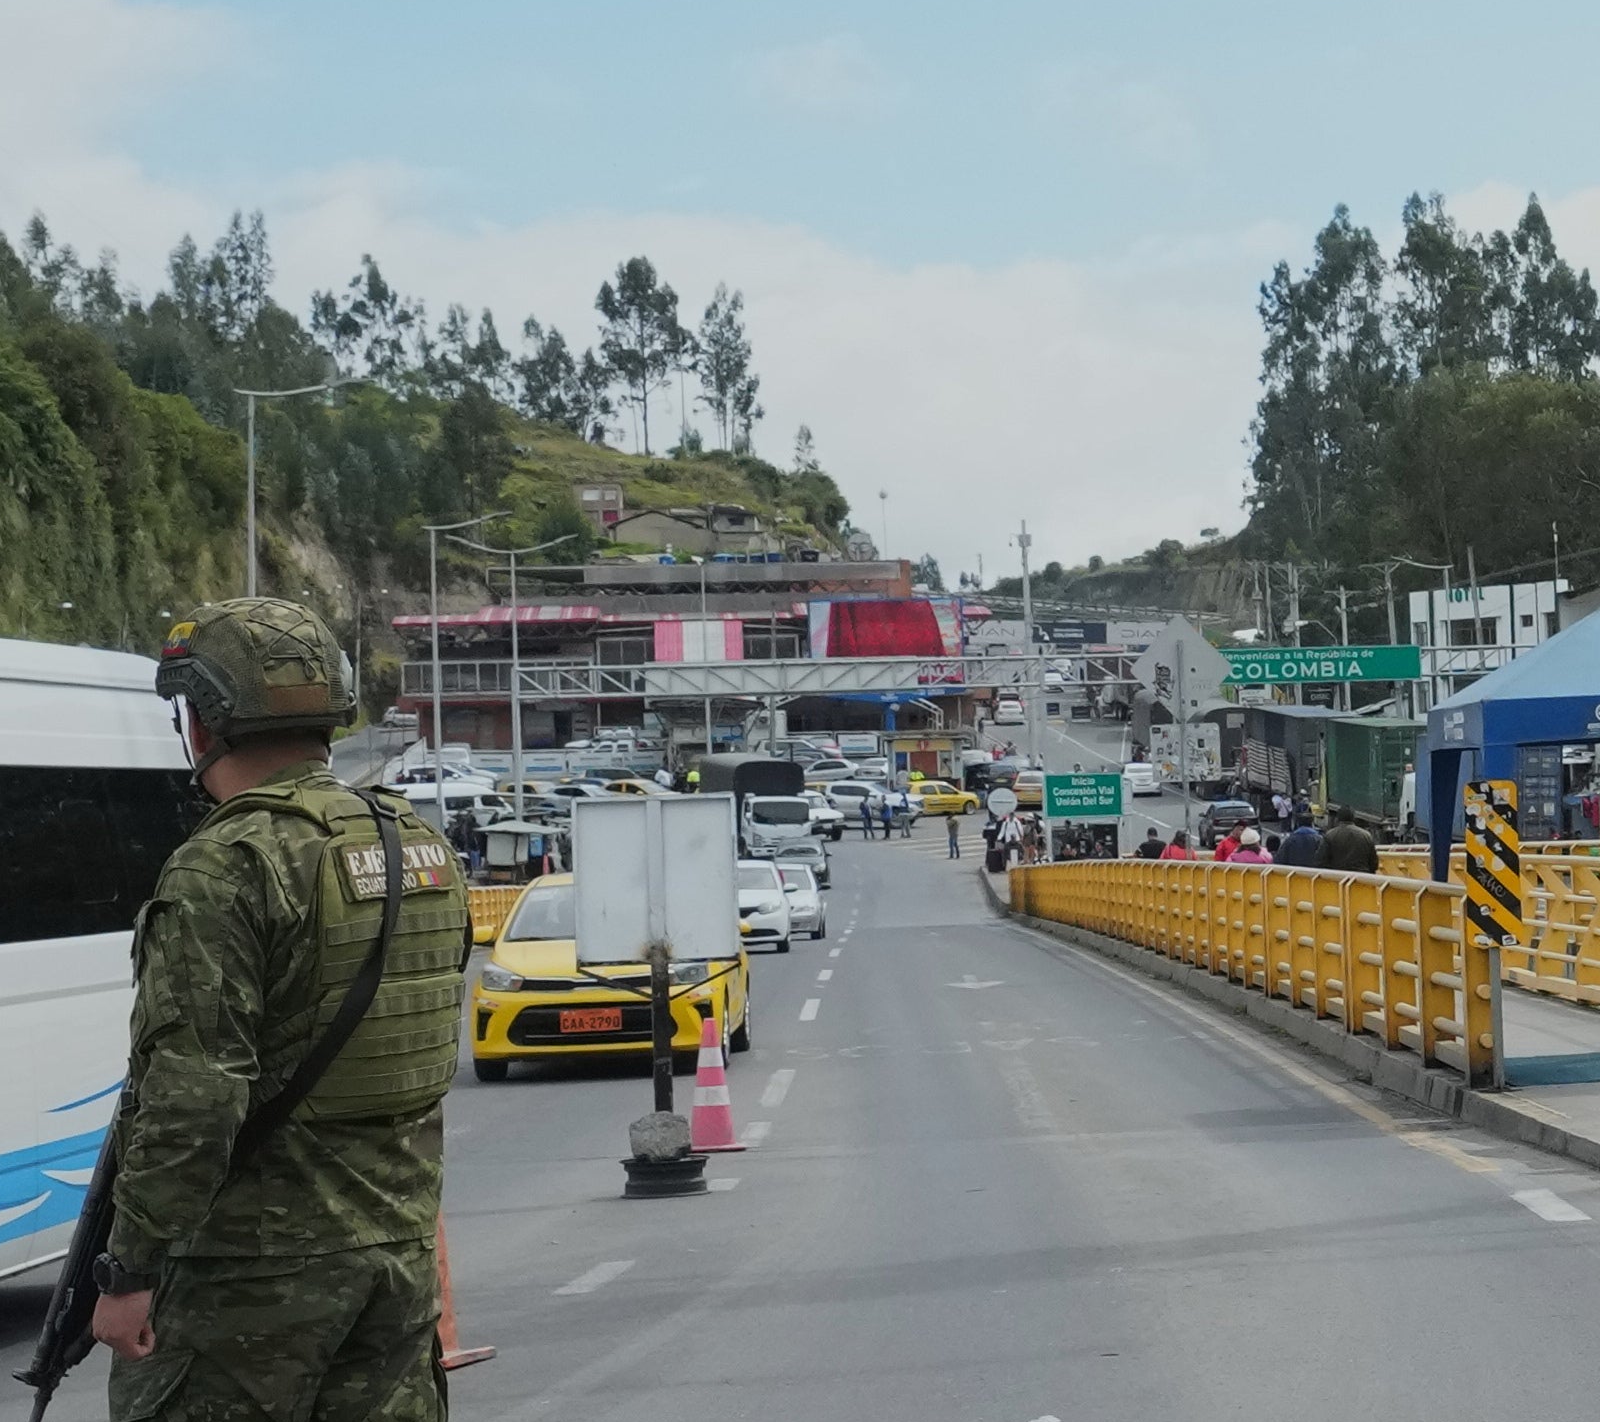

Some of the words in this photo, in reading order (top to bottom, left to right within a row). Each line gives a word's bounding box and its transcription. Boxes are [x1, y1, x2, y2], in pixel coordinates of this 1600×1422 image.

[1448, 586, 1485, 603] OTL
[1283, 652, 1291, 660] a
[1294, 651, 1303, 660] la
[1306, 649, 1358, 660] República
[1361, 650, 1374, 658] de
[1230, 661, 1364, 679] COLOMBIA
[1098, 785, 1115, 795] Vial
[1055, 797, 1081, 806] Unión
[1082, 796, 1097, 806] Del
[1098, 796, 1114, 805] Sur
[346, 844, 447, 876] EJÉCITO
